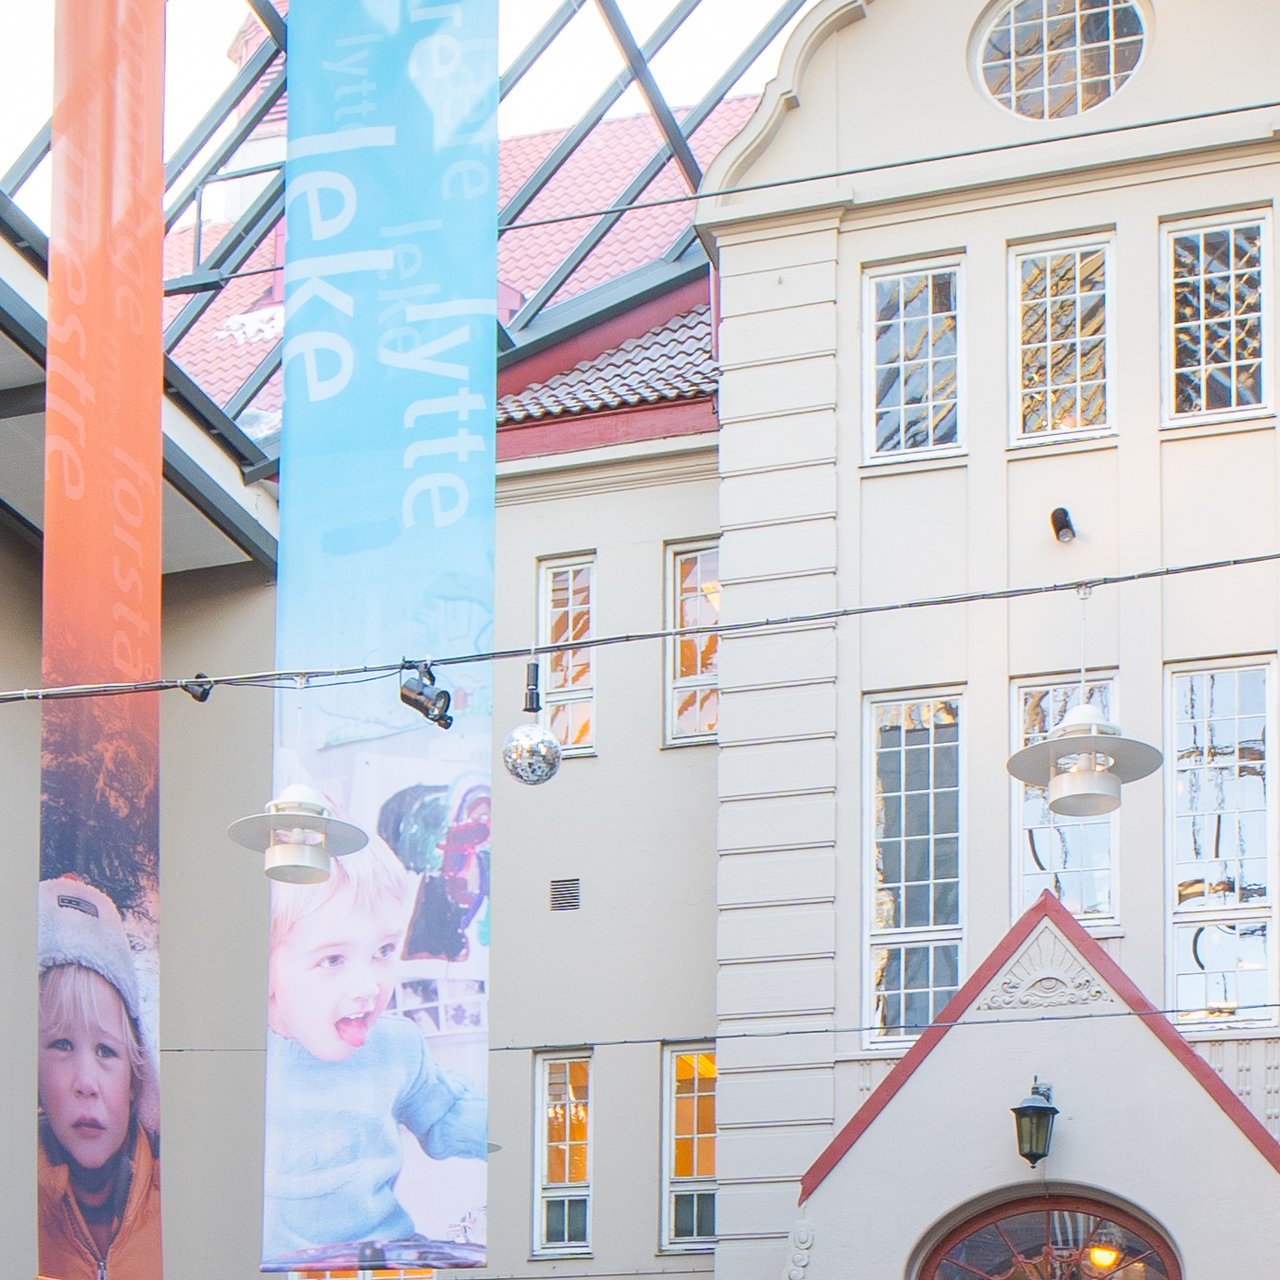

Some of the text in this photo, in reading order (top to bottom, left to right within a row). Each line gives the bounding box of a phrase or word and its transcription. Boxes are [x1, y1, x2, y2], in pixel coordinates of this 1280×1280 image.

[283, 126, 396, 402] leke
[379, 299, 497, 529] lytte
[113, 446, 155, 681] forstå
